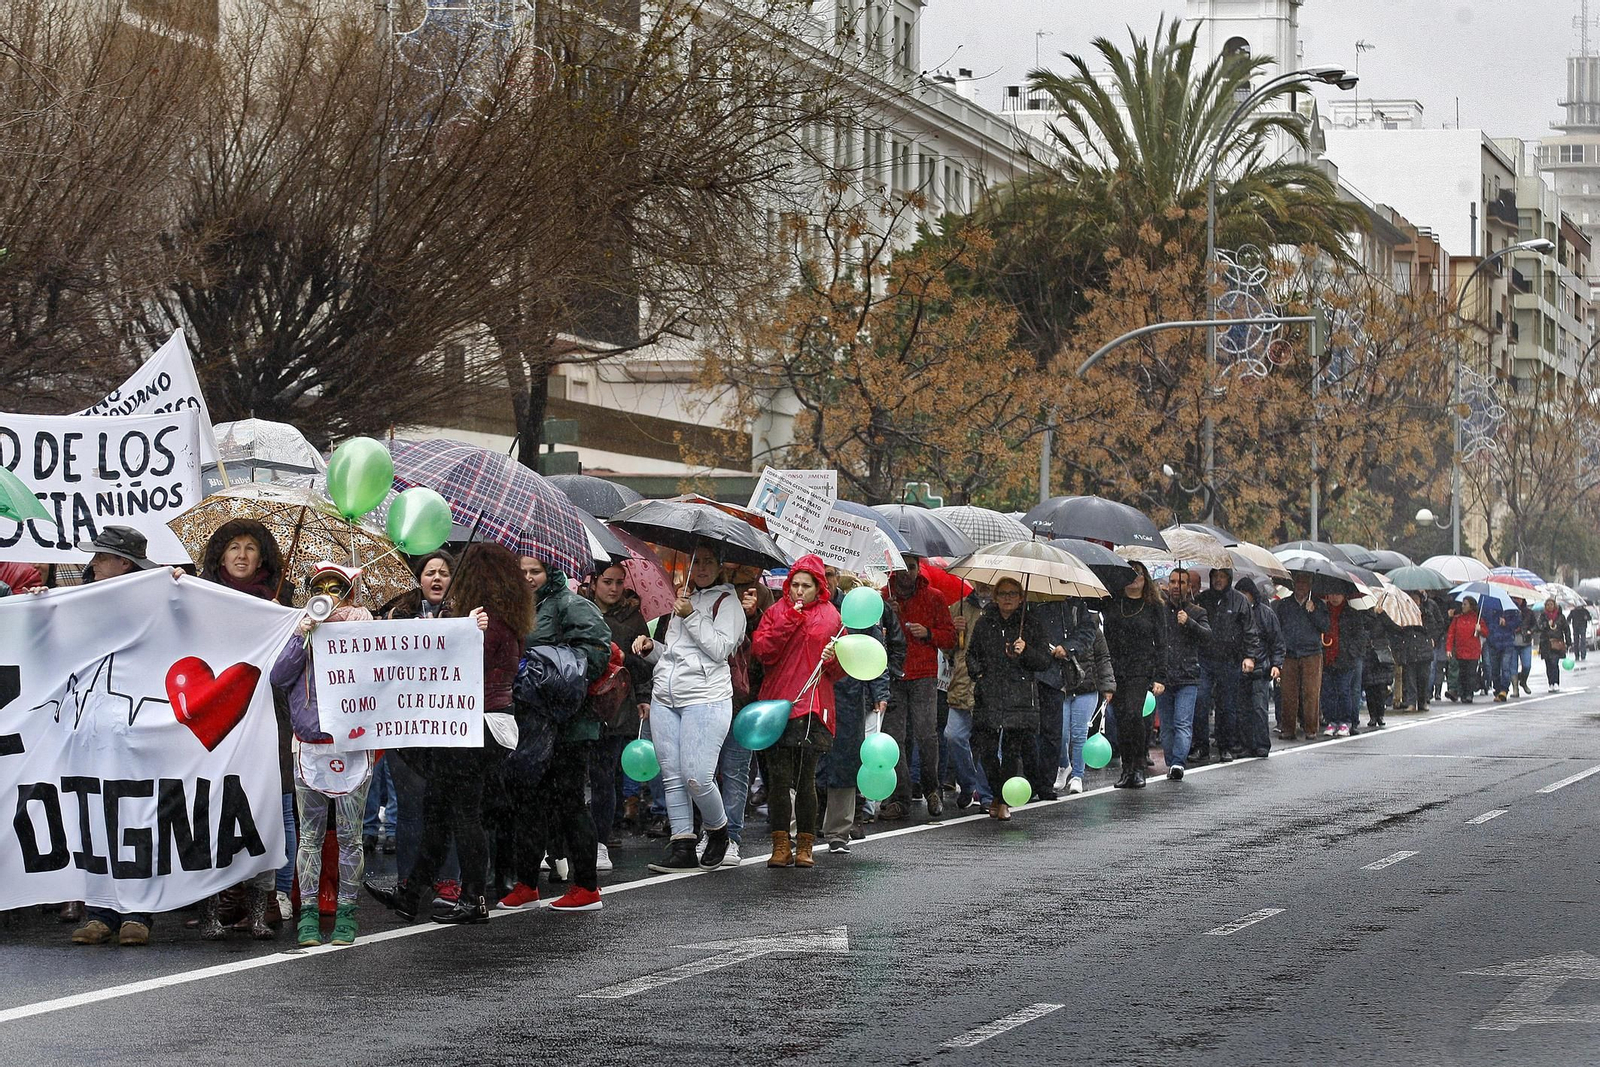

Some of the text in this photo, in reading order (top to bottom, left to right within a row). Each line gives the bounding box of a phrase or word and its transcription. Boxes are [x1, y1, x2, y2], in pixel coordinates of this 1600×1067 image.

[34, 431, 83, 483] DE
[98, 425, 179, 480] LOS
[96, 481, 183, 517] NIÑOS
[796, 495, 822, 511] MALTRATO
[794, 513, 809, 524] BASTA
[796, 502, 821, 519] PACIENTES
[829, 544, 861, 557] GESTORES
[327, 635, 446, 655] READMISION
[327, 666, 462, 686] DRA MUGUERZA
[341, 693, 476, 713] COMO CIRUJANO
[375, 719, 468, 737] PEDIATRICO
[13, 774, 267, 880] DIGNA
